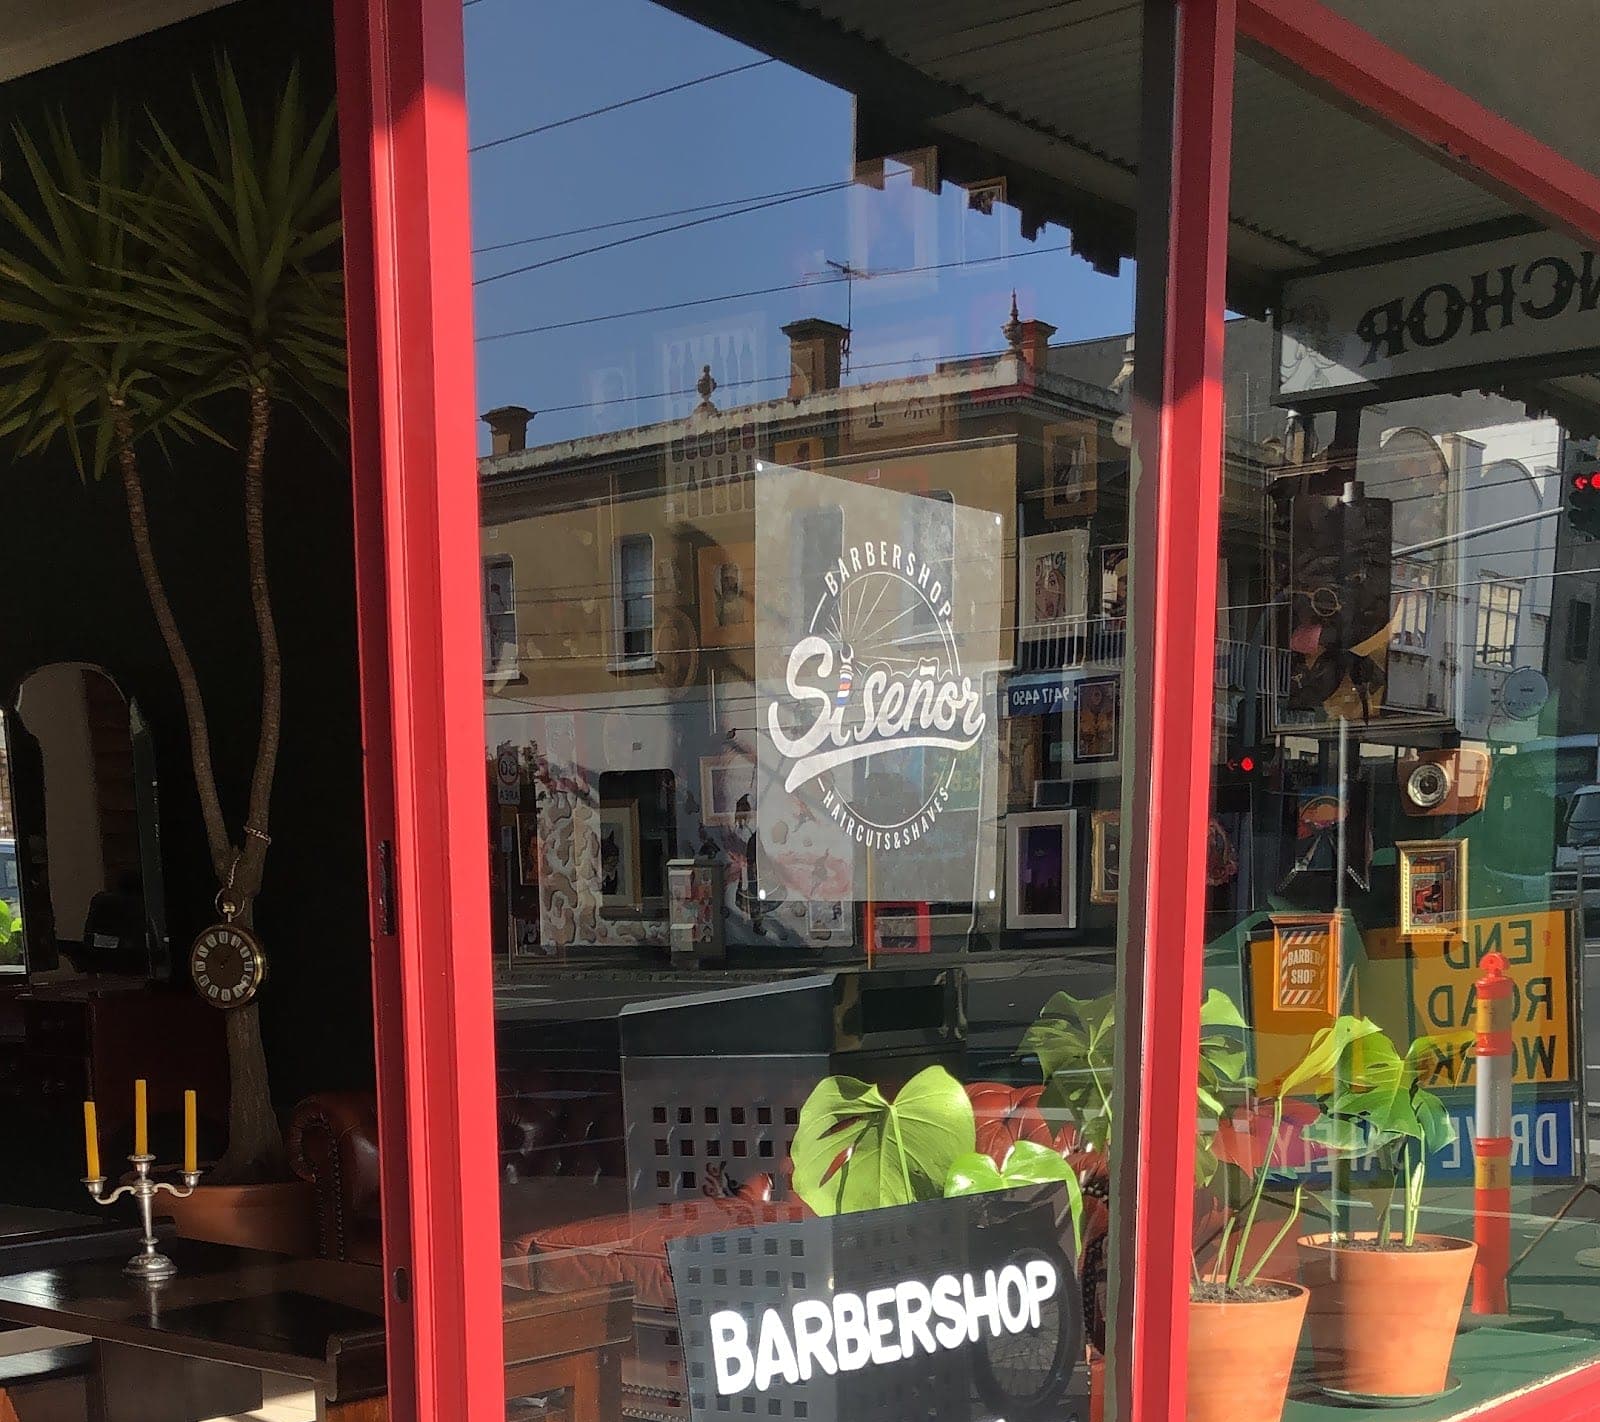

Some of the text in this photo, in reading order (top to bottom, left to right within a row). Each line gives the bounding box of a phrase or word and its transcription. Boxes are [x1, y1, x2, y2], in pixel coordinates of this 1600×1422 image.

[824, 541, 952, 617] BARBERSHOP
[1287, 949, 1322, 967] BARBER
[1290, 969, 1316, 985] SHOP
[710, 1260, 1057, 1395] BARBERSHOP
